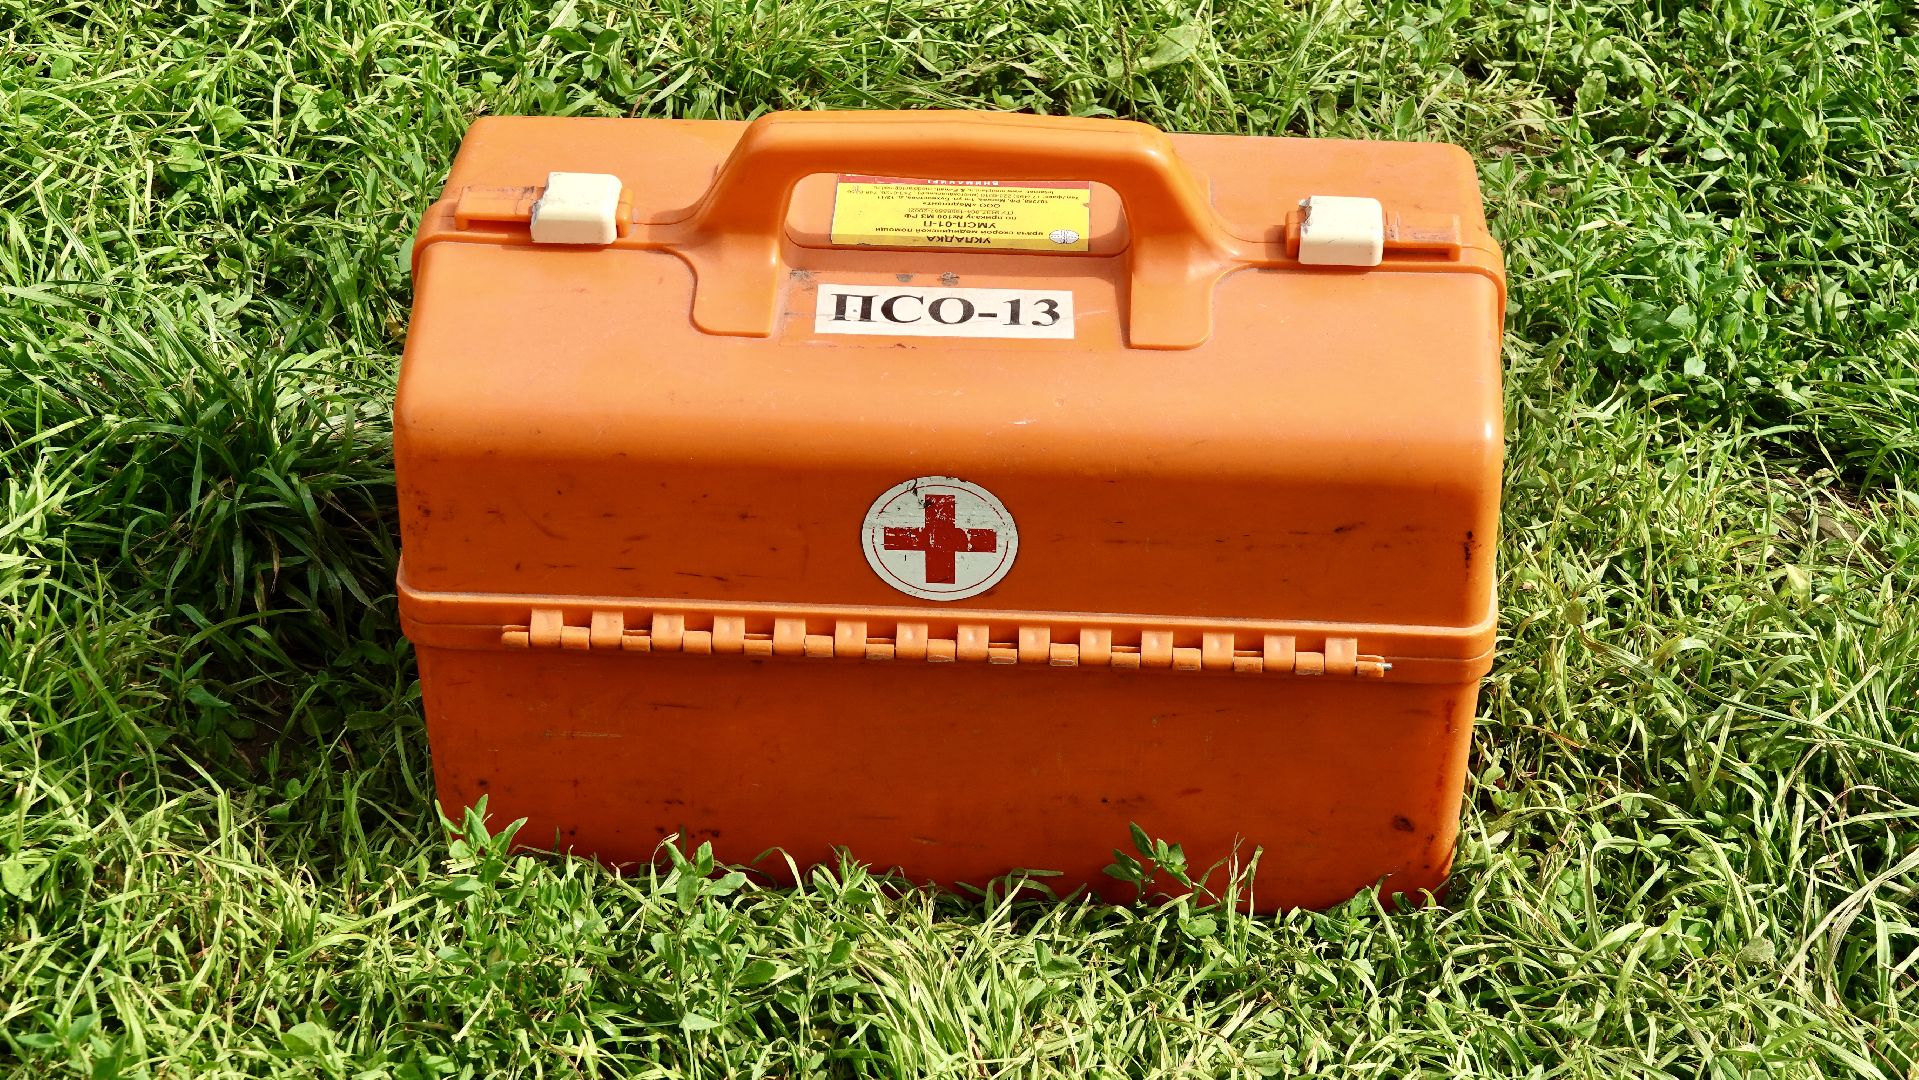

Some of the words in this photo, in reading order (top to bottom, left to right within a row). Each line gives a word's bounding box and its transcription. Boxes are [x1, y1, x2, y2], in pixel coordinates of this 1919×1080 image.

[923, 220, 996, 229] УМСП-01-П
[926, 234, 991, 244] УКЛАДКА
[829, 293, 1061, 327] ПСО-13
